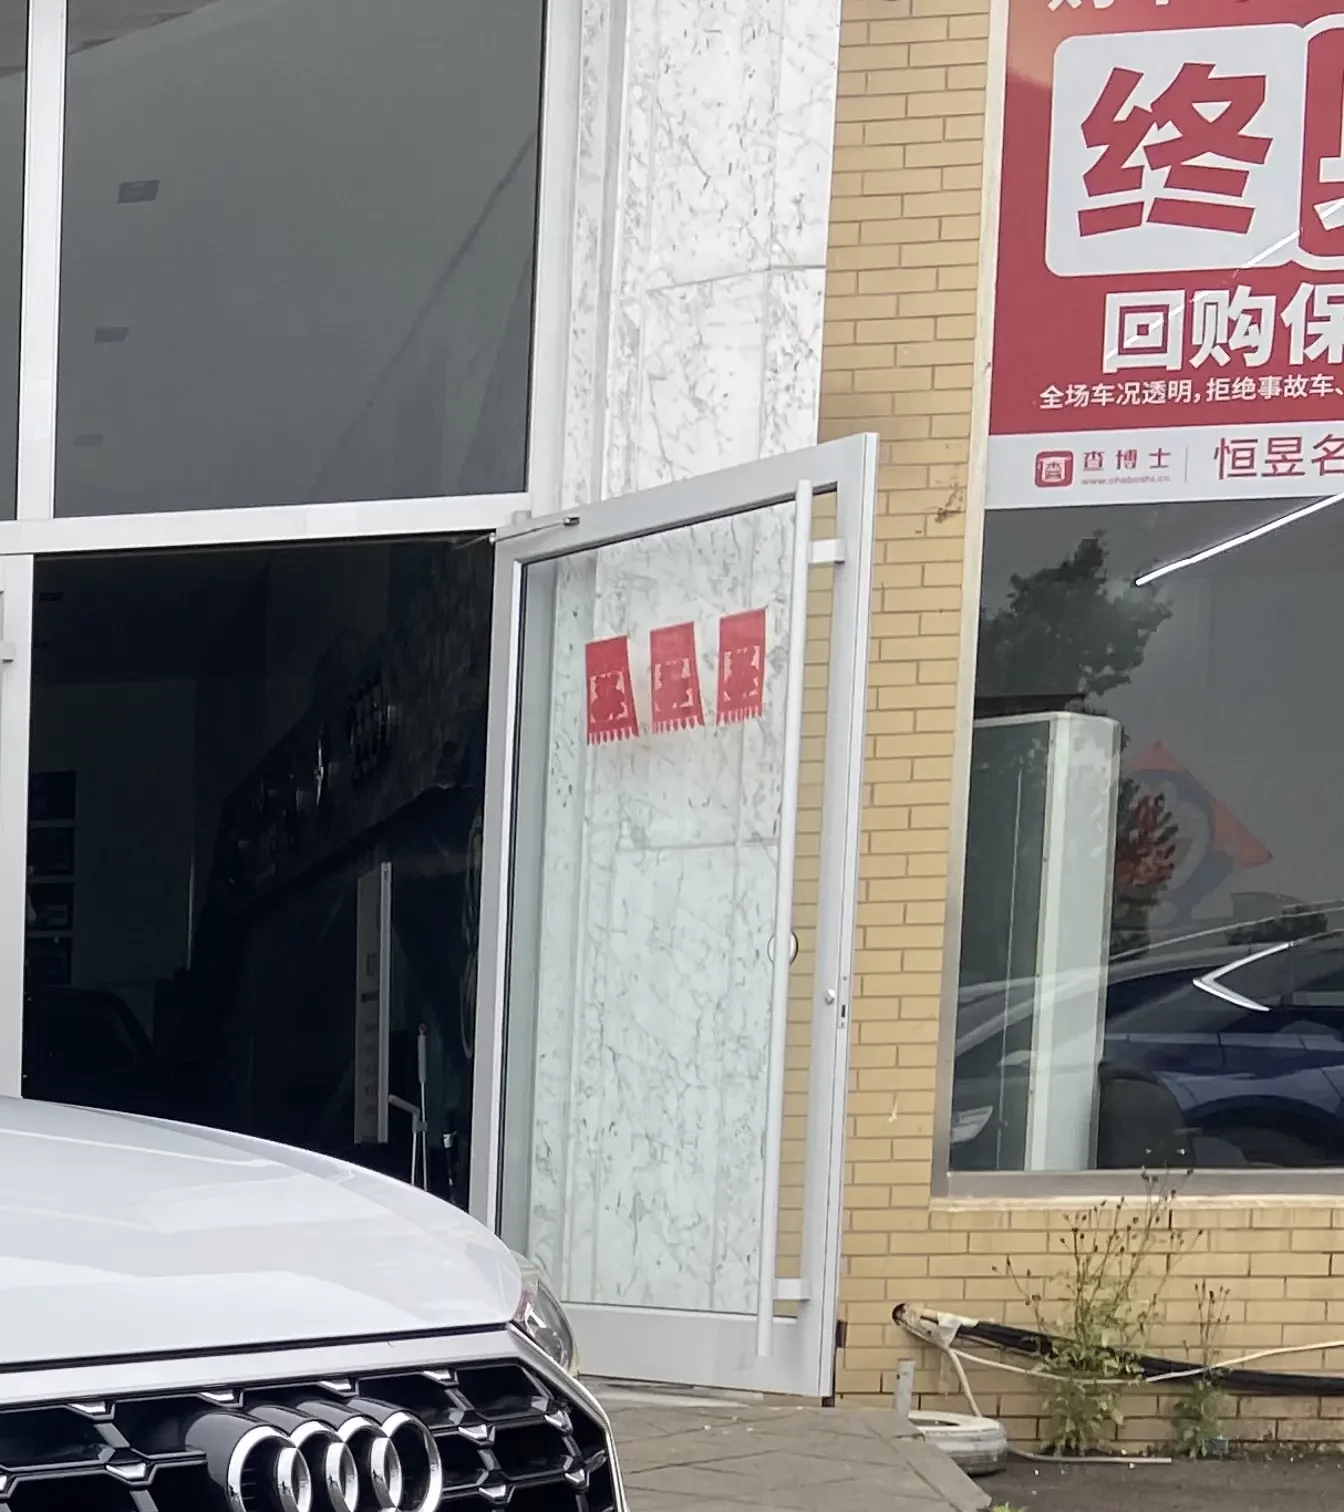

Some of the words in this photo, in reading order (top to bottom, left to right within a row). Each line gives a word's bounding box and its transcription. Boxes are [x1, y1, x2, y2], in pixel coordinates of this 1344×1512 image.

[1078, 62, 1344, 237] 终
[1083, 447, 1171, 471] 查博士
